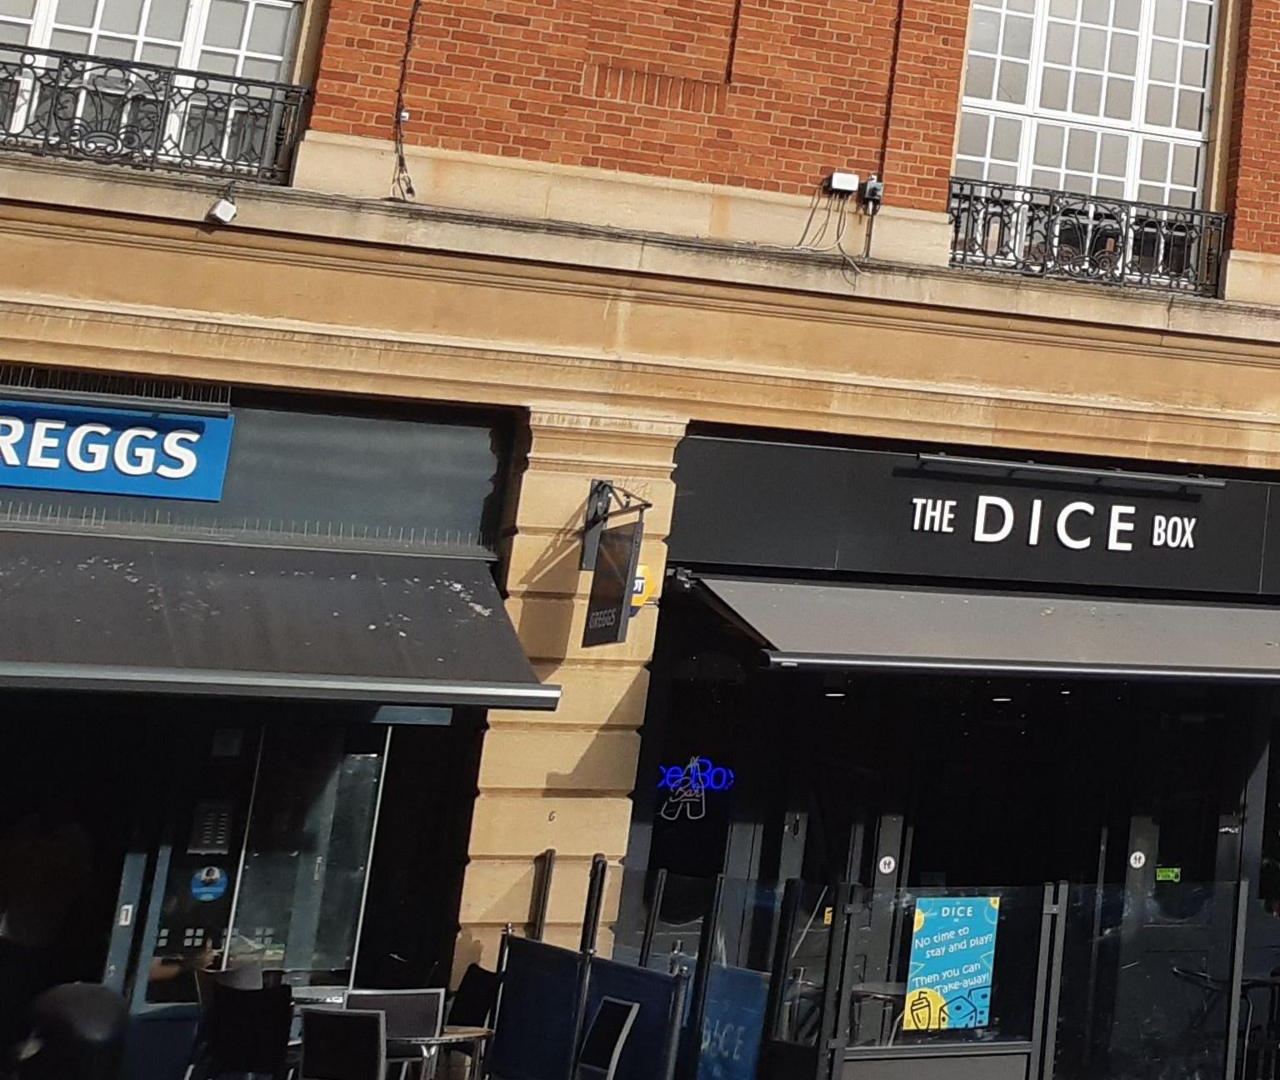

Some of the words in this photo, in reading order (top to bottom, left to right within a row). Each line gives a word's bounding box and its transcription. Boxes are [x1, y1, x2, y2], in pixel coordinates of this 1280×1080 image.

[911, 497, 957, 533] THE
[973, 495, 1136, 551] DICE
[1152, 514, 1197, 548] BOX
[941, 906, 974, 918] DICE
[915, 937, 930, 948] No
[933, 931, 956, 943] time
[958, 927, 969, 936] to
[926, 946, 946, 958] stay
[949, 941, 967, 952] and
[970, 934, 993, 947] play?
[912, 974, 939, 987] Then
[942, 968, 960, 980] you
